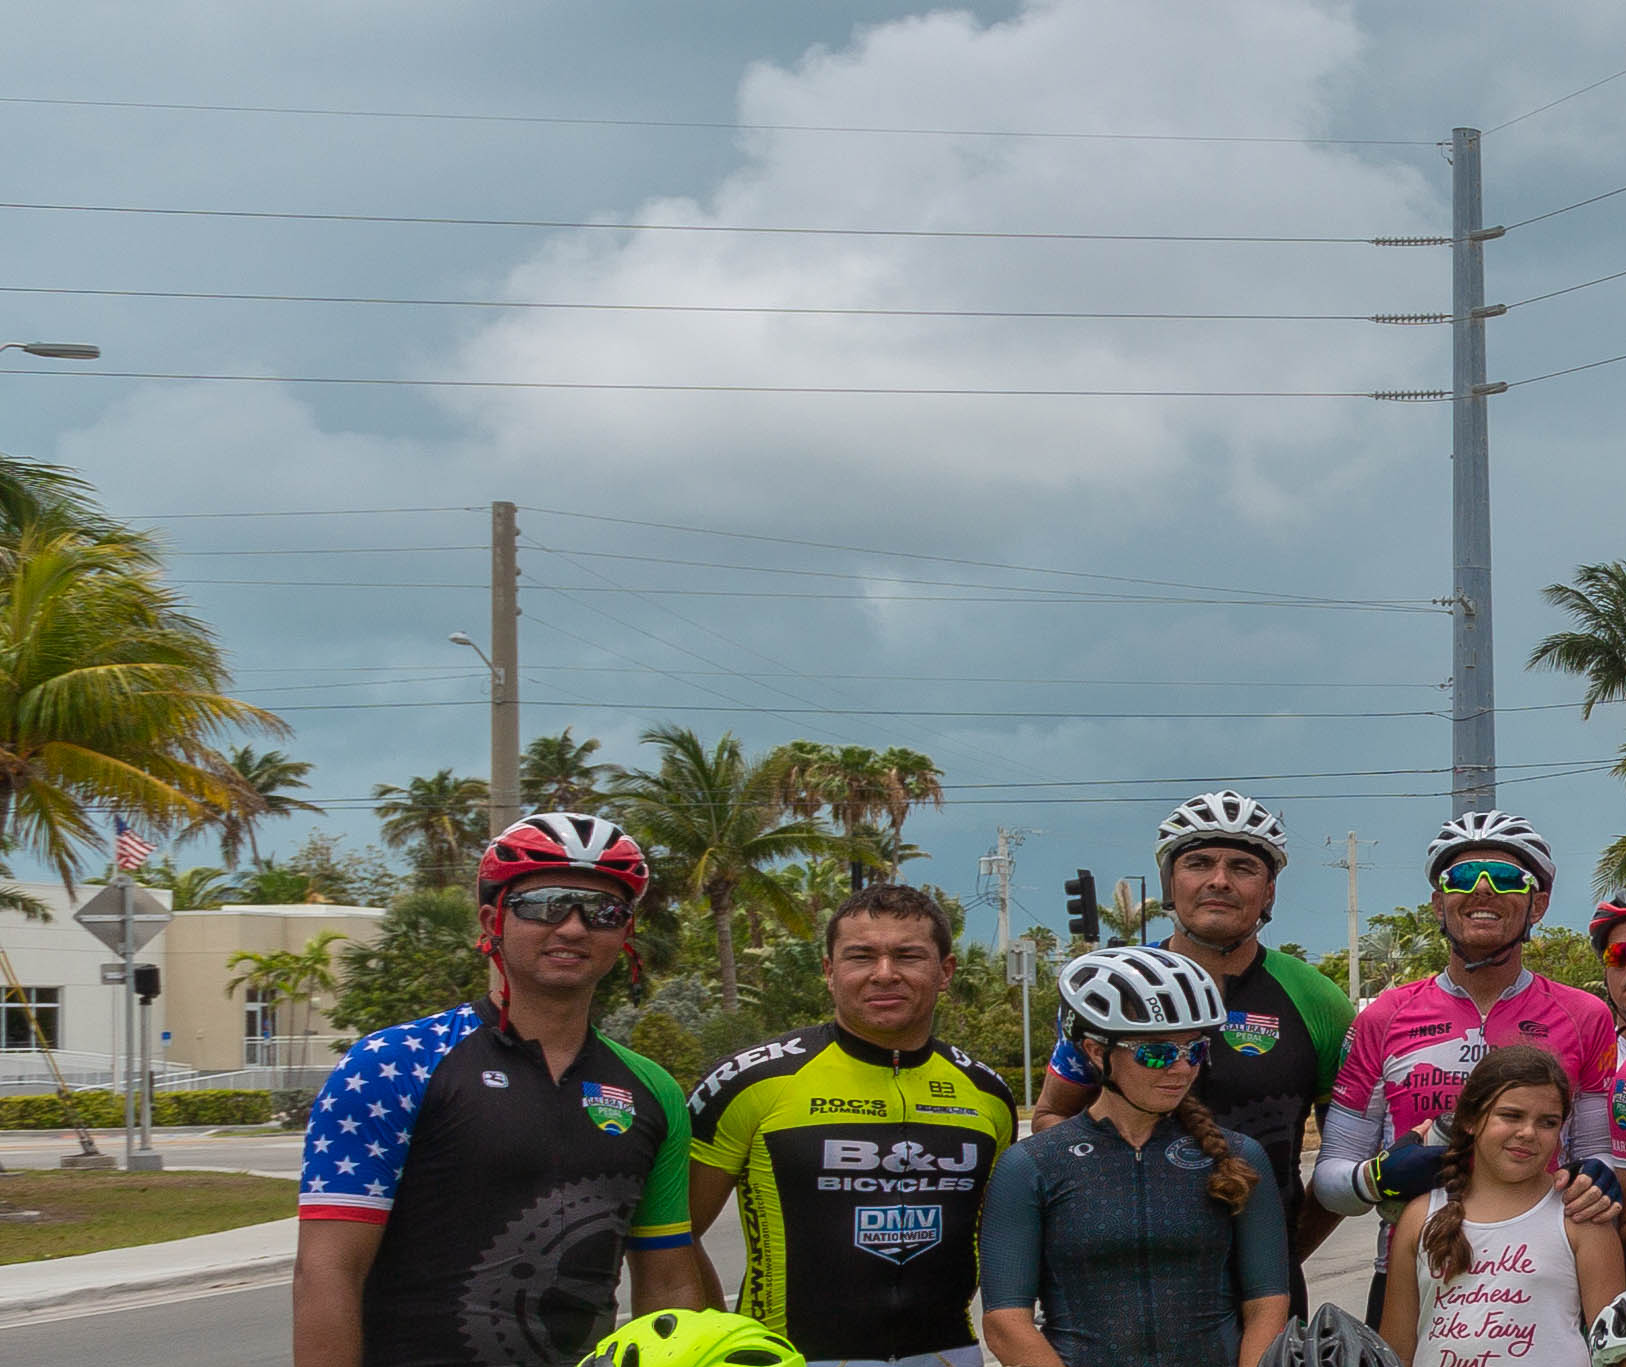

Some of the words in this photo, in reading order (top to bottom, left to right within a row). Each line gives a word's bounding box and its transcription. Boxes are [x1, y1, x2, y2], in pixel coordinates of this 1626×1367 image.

[1236, 1032, 1263, 1043] PEDAL
[1408, 1021, 1452, 1039] #NQSF
[686, 1036, 807, 1115] TREK
[809, 1097, 887, 1109] DOC'S
[1412, 1092, 1430, 1113] TO
[809, 1107, 887, 1118] PLUMBING
[822, 1139, 978, 1173] B&J
[817, 1176, 976, 1193] BICYCLES
[860, 1209, 938, 1230] DMV
[862, 1230, 936, 1243] NATIONWIDE
[1433, 1283, 1532, 1310] Kindness
[1428, 1311, 1471, 1341] Like
[1474, 1311, 1537, 1358] Fairy
